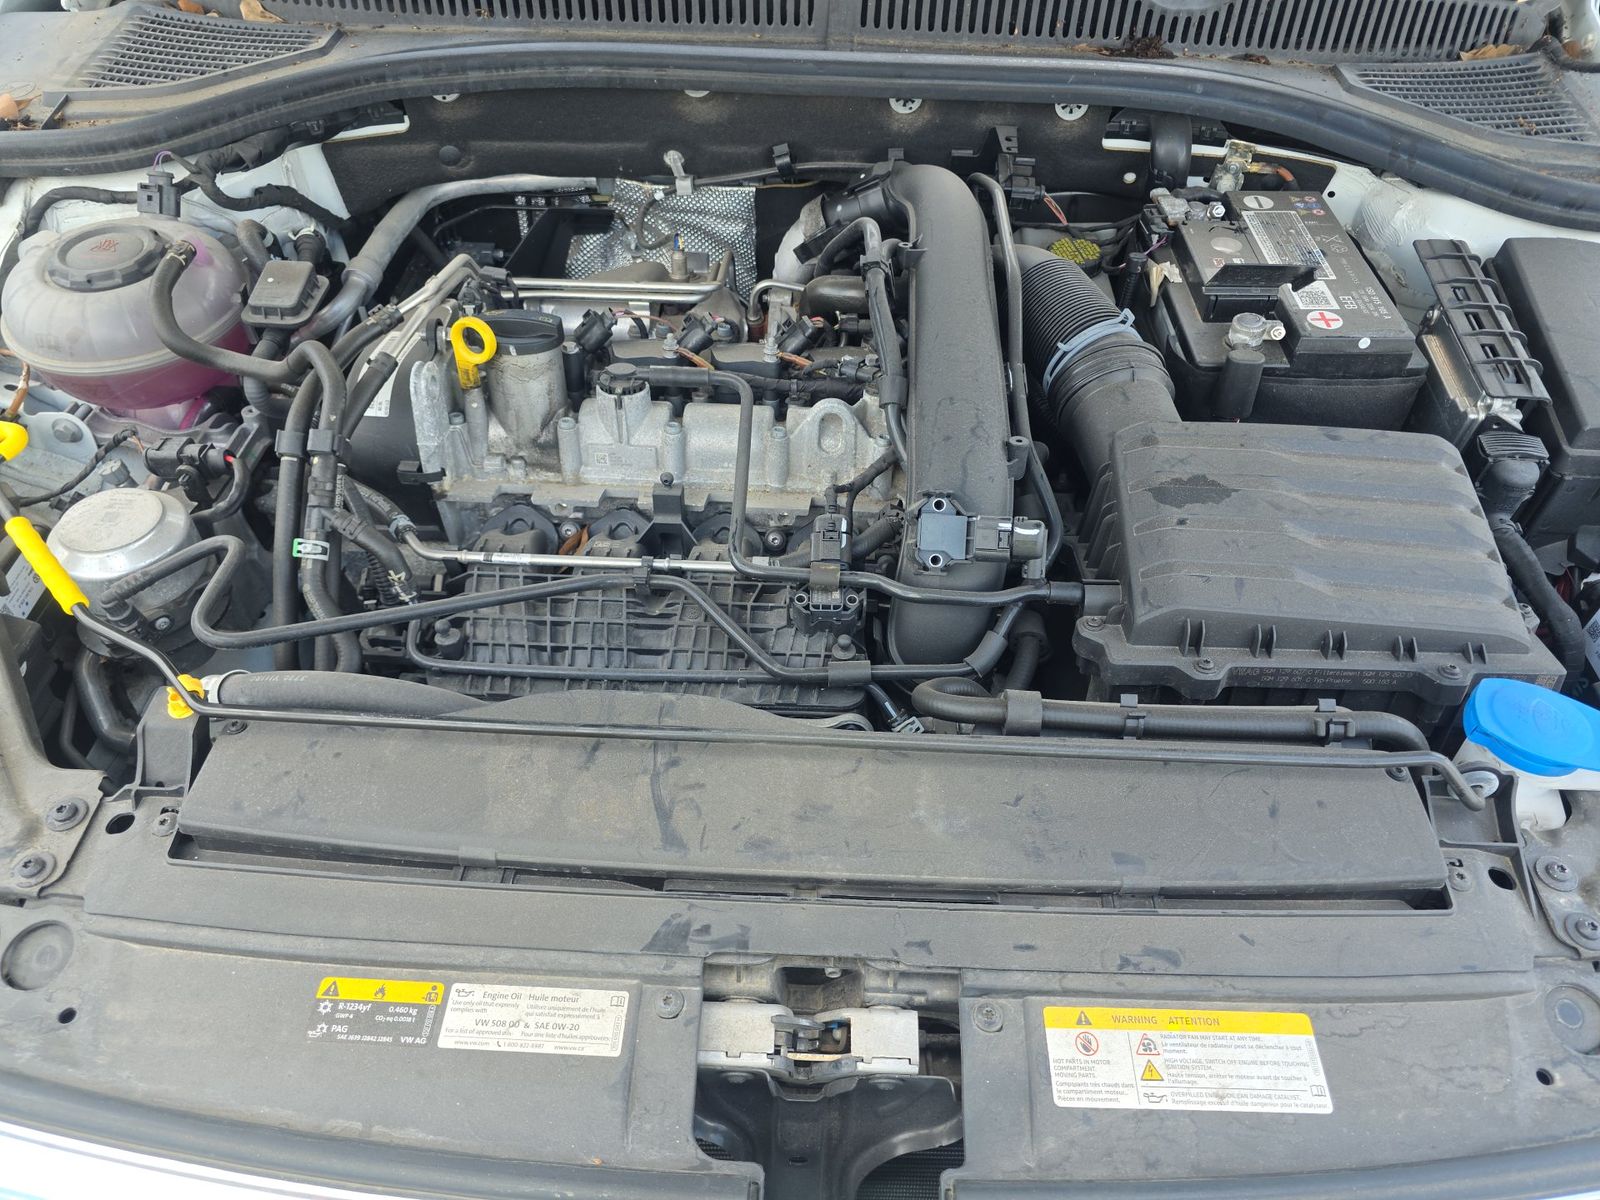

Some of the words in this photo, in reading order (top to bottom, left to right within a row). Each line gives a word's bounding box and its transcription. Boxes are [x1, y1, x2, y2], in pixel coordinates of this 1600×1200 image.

[1339, 296, 1358, 310] EFB
[482, 991, 509, 1001] Engine
[511, 992, 522, 1000] Oil
[528, 993, 549, 1001] Huile
[550, 995, 579, 1003] moteur
[338, 1002, 372, 1013] R-1234yf
[409, 1007, 418, 1016] kg
[491, 1019, 506, 1027] 508
[509, 1020, 520, 1028] 00
[552, 1022, 580, 1031] 0W-20
[1112, 1015, 1158, 1024] WARNING
[1168, 1016, 1220, 1026] ATTENTION
[331, 1024, 349, 1033] PAG
